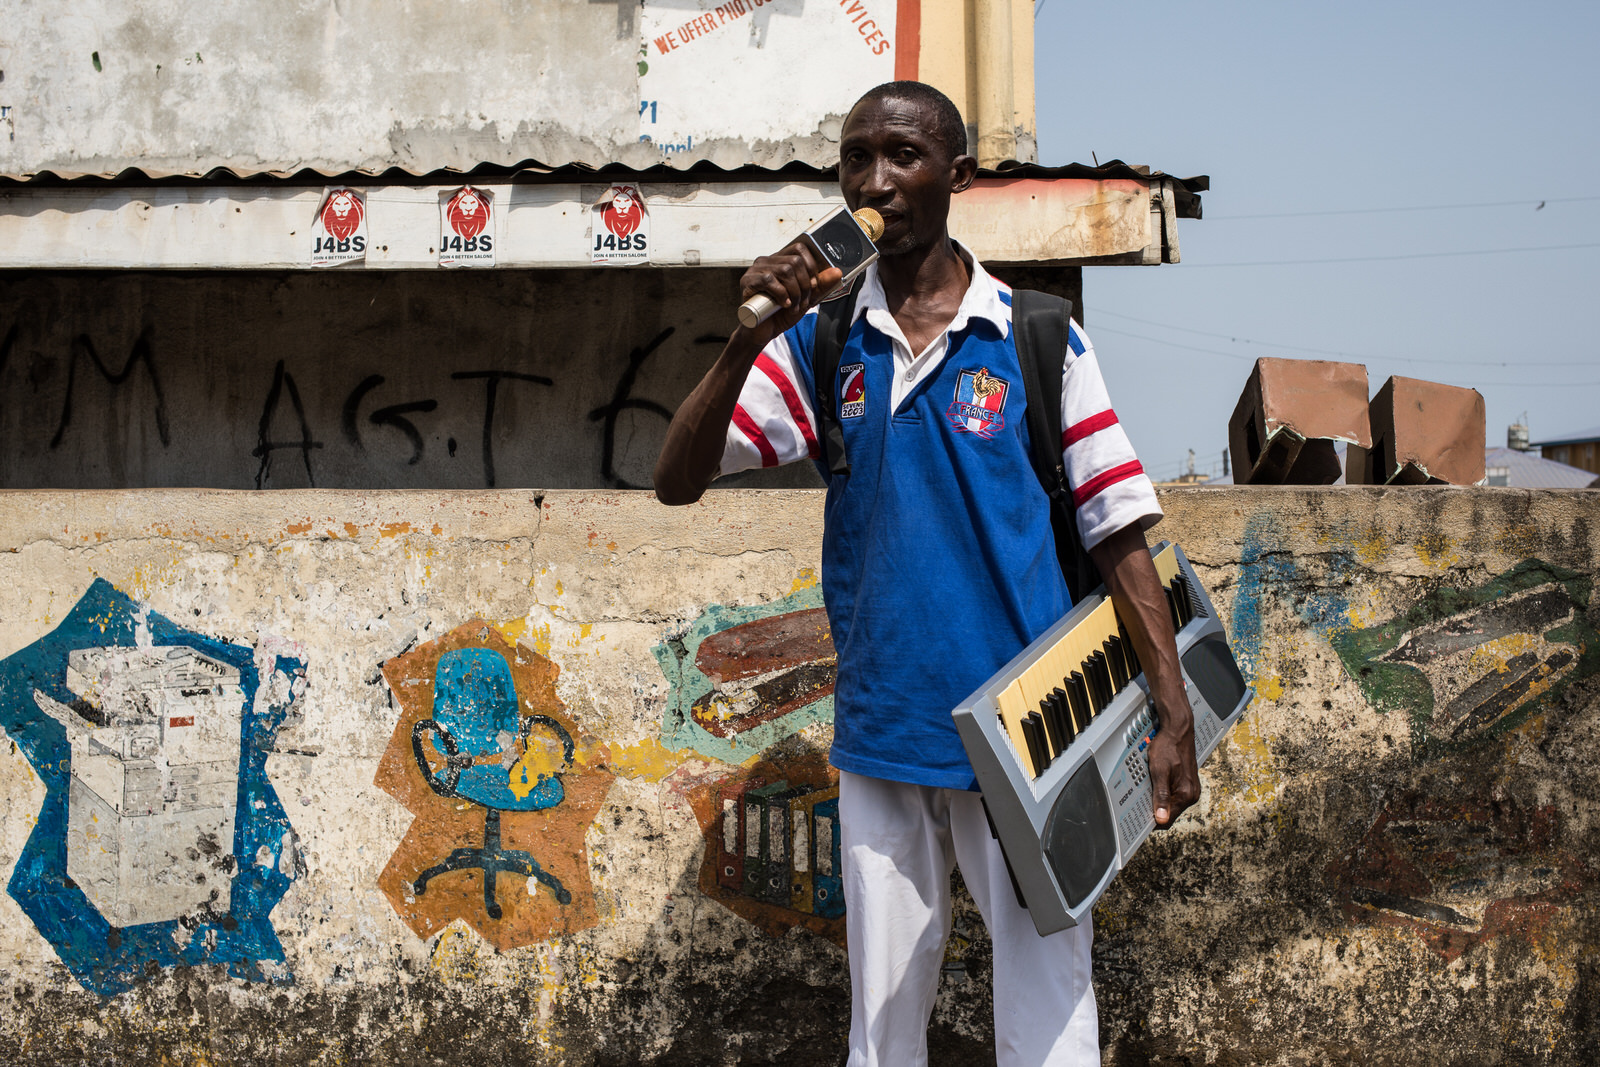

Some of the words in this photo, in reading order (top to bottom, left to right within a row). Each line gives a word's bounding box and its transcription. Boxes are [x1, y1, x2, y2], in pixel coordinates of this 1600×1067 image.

[839, 0, 890, 55] VICES
[653, 31, 679, 55] WE
[313, 236, 366, 253] J4BS
[440, 234, 493, 253] J4BS
[593, 233, 647, 251] J4BS
[842, 402, 864, 410] SEVENS
[842, 408, 863, 417] 2003
[960, 404, 995, 422] FRANCE
